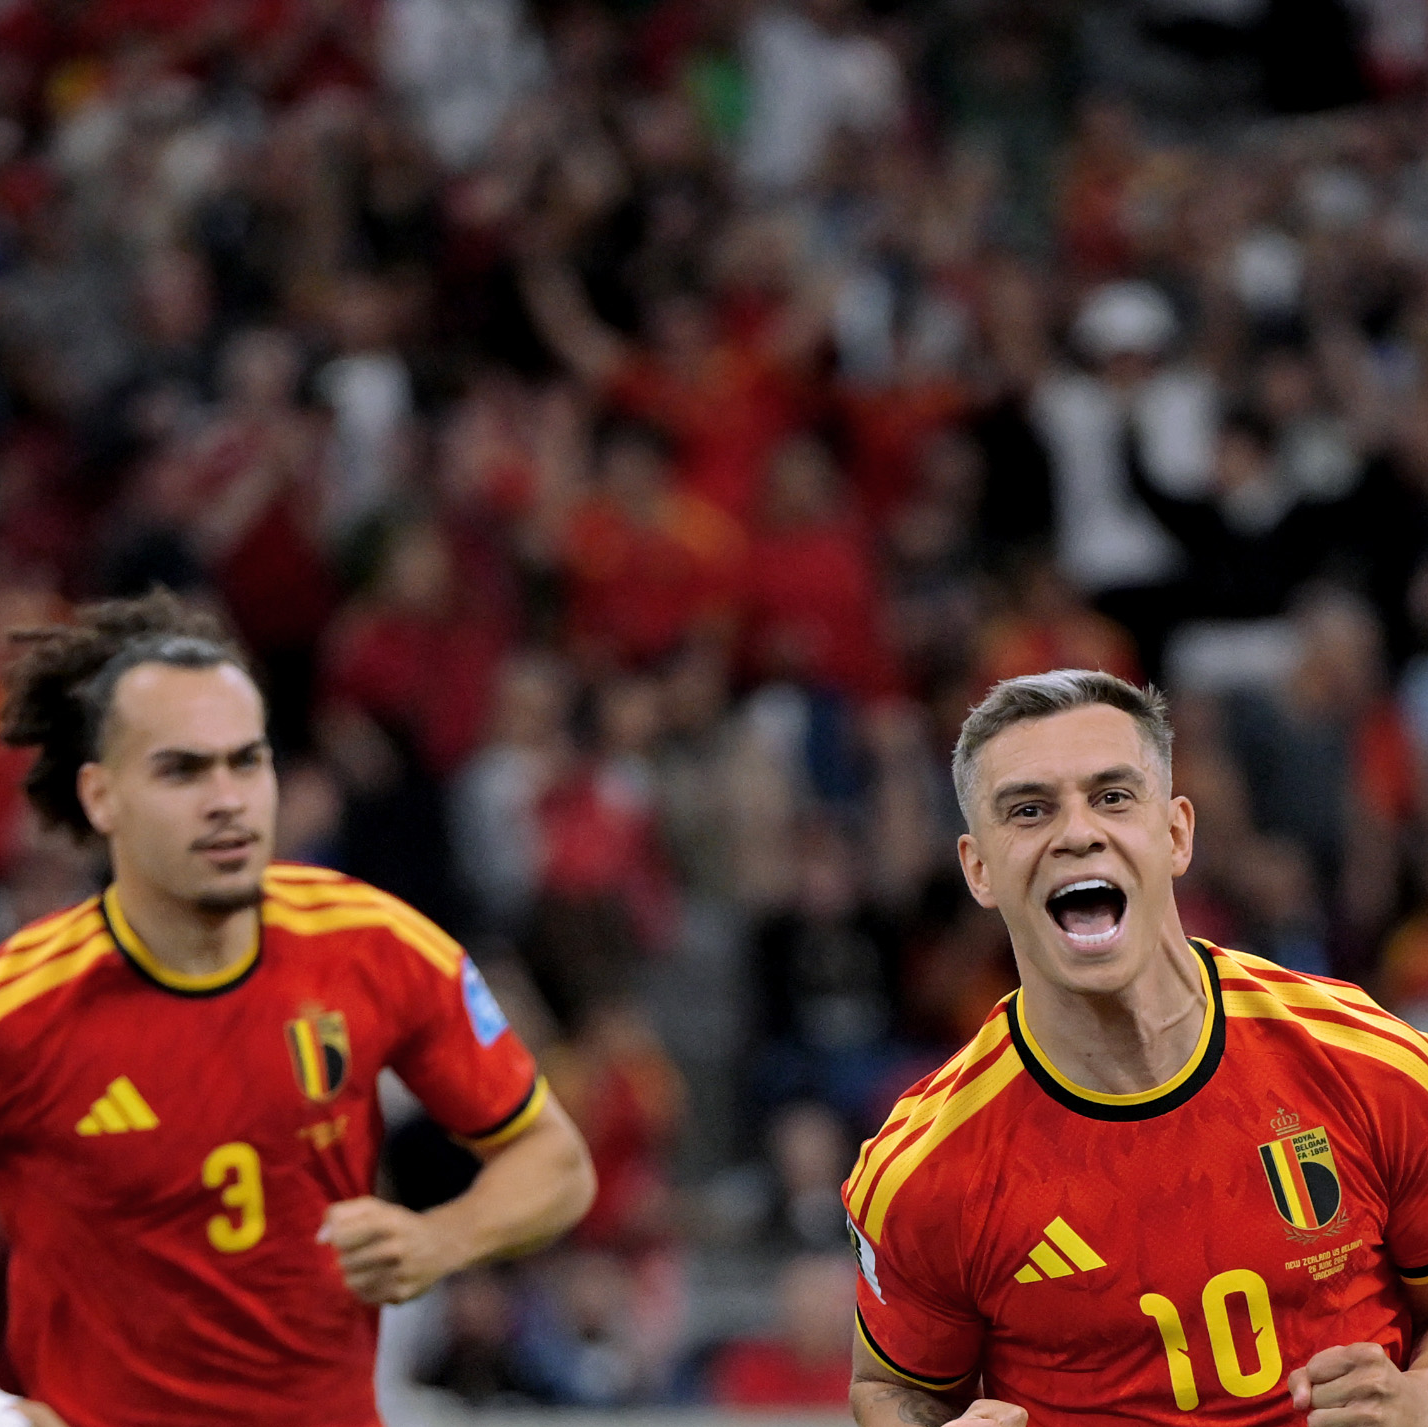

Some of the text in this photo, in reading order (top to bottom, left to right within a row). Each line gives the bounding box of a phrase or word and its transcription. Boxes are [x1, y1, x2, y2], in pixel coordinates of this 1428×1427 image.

[1292, 1133, 1316, 1144] ROYAL
[1295, 1138, 1327, 1152] BELGIAN
[203, 1142, 265, 1253] 3
[1139, 1269, 1283, 1411] 10
